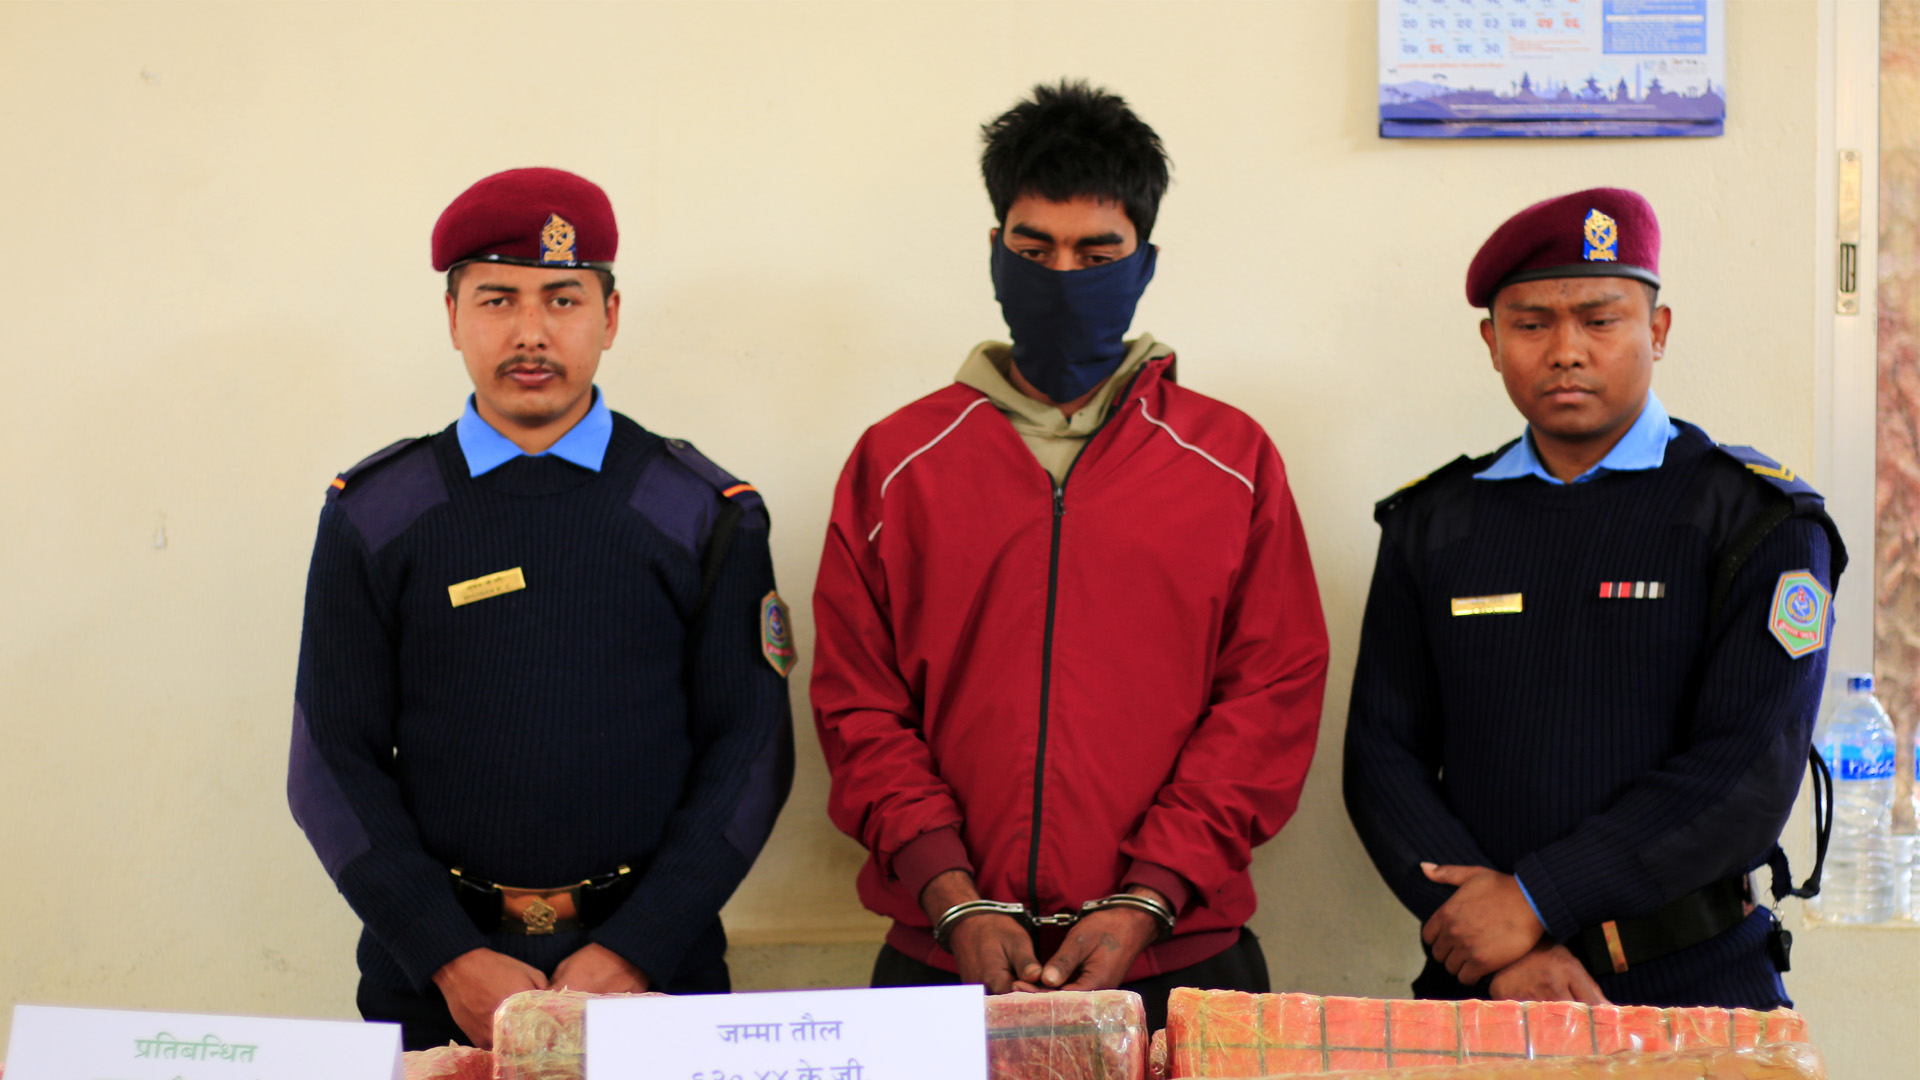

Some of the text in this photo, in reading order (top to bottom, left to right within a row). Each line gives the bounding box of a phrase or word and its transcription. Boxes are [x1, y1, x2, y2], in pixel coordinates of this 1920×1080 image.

[716, 1012, 844, 1043] जम्मा तौल
[134, 1031, 258, 1063] प्रतिबन्धित
